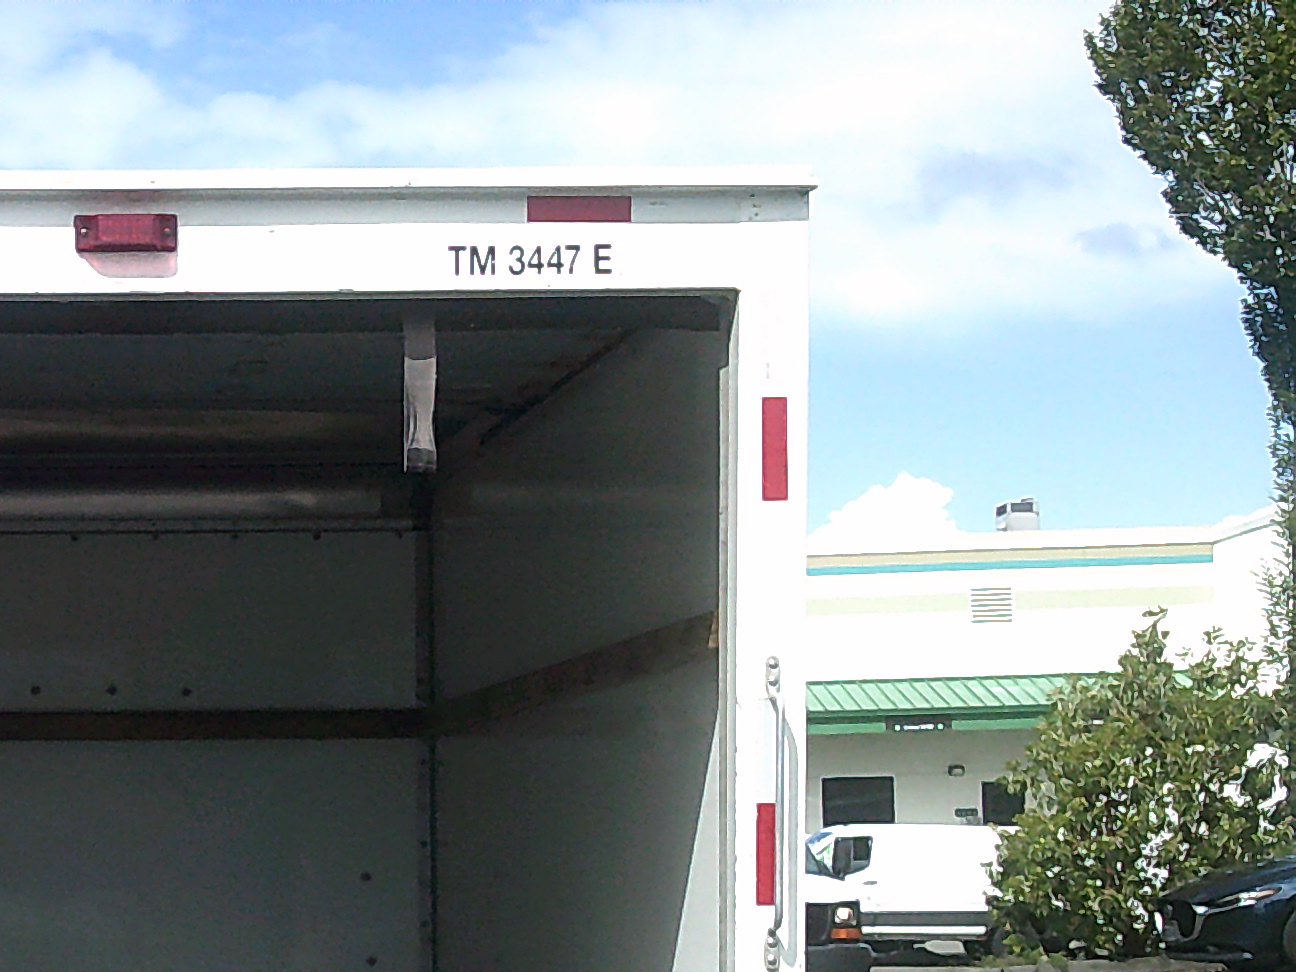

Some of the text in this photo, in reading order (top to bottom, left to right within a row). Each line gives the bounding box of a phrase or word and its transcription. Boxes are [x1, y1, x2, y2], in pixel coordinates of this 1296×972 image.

[448, 243, 613, 276] TM 3447 E
